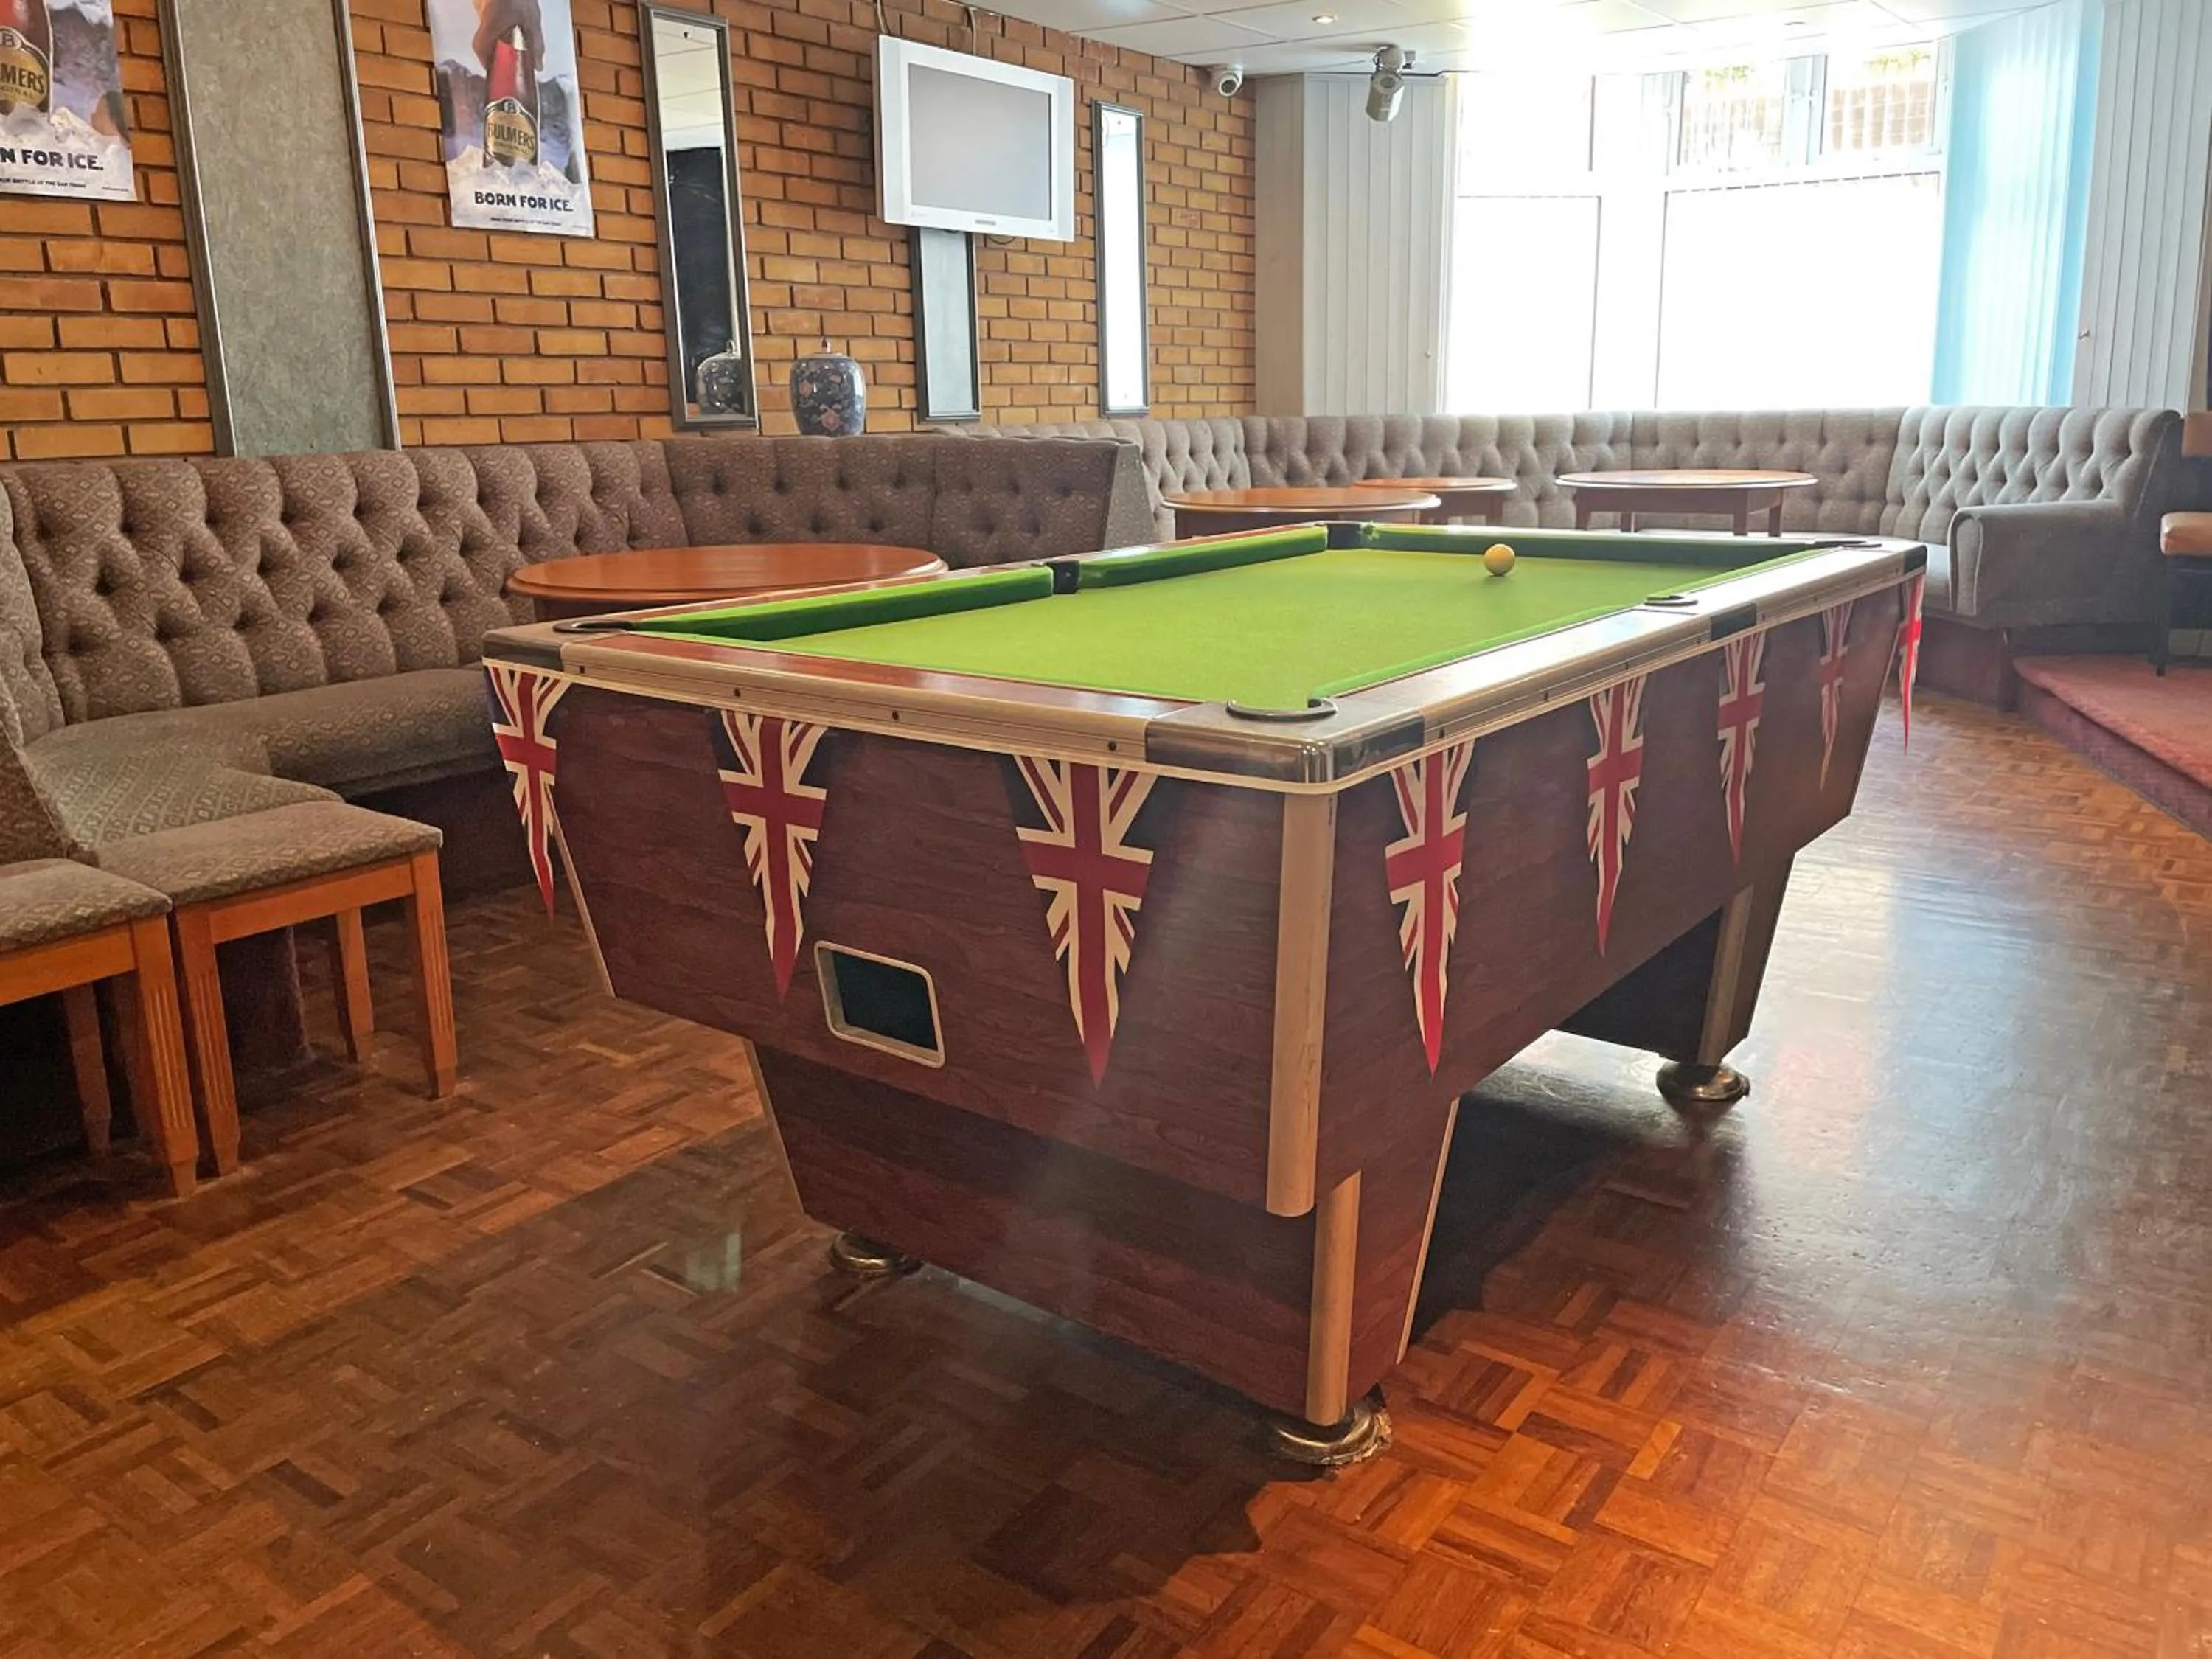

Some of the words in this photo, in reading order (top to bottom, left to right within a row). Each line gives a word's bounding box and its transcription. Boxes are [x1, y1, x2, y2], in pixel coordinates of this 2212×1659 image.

[487, 123, 535, 150] BULMERS
[21, 149, 64, 167] FOR
[67, 153, 104, 170] ICE.
[474, 191, 516, 207] BORN
[519, 195, 548, 210] FOR
